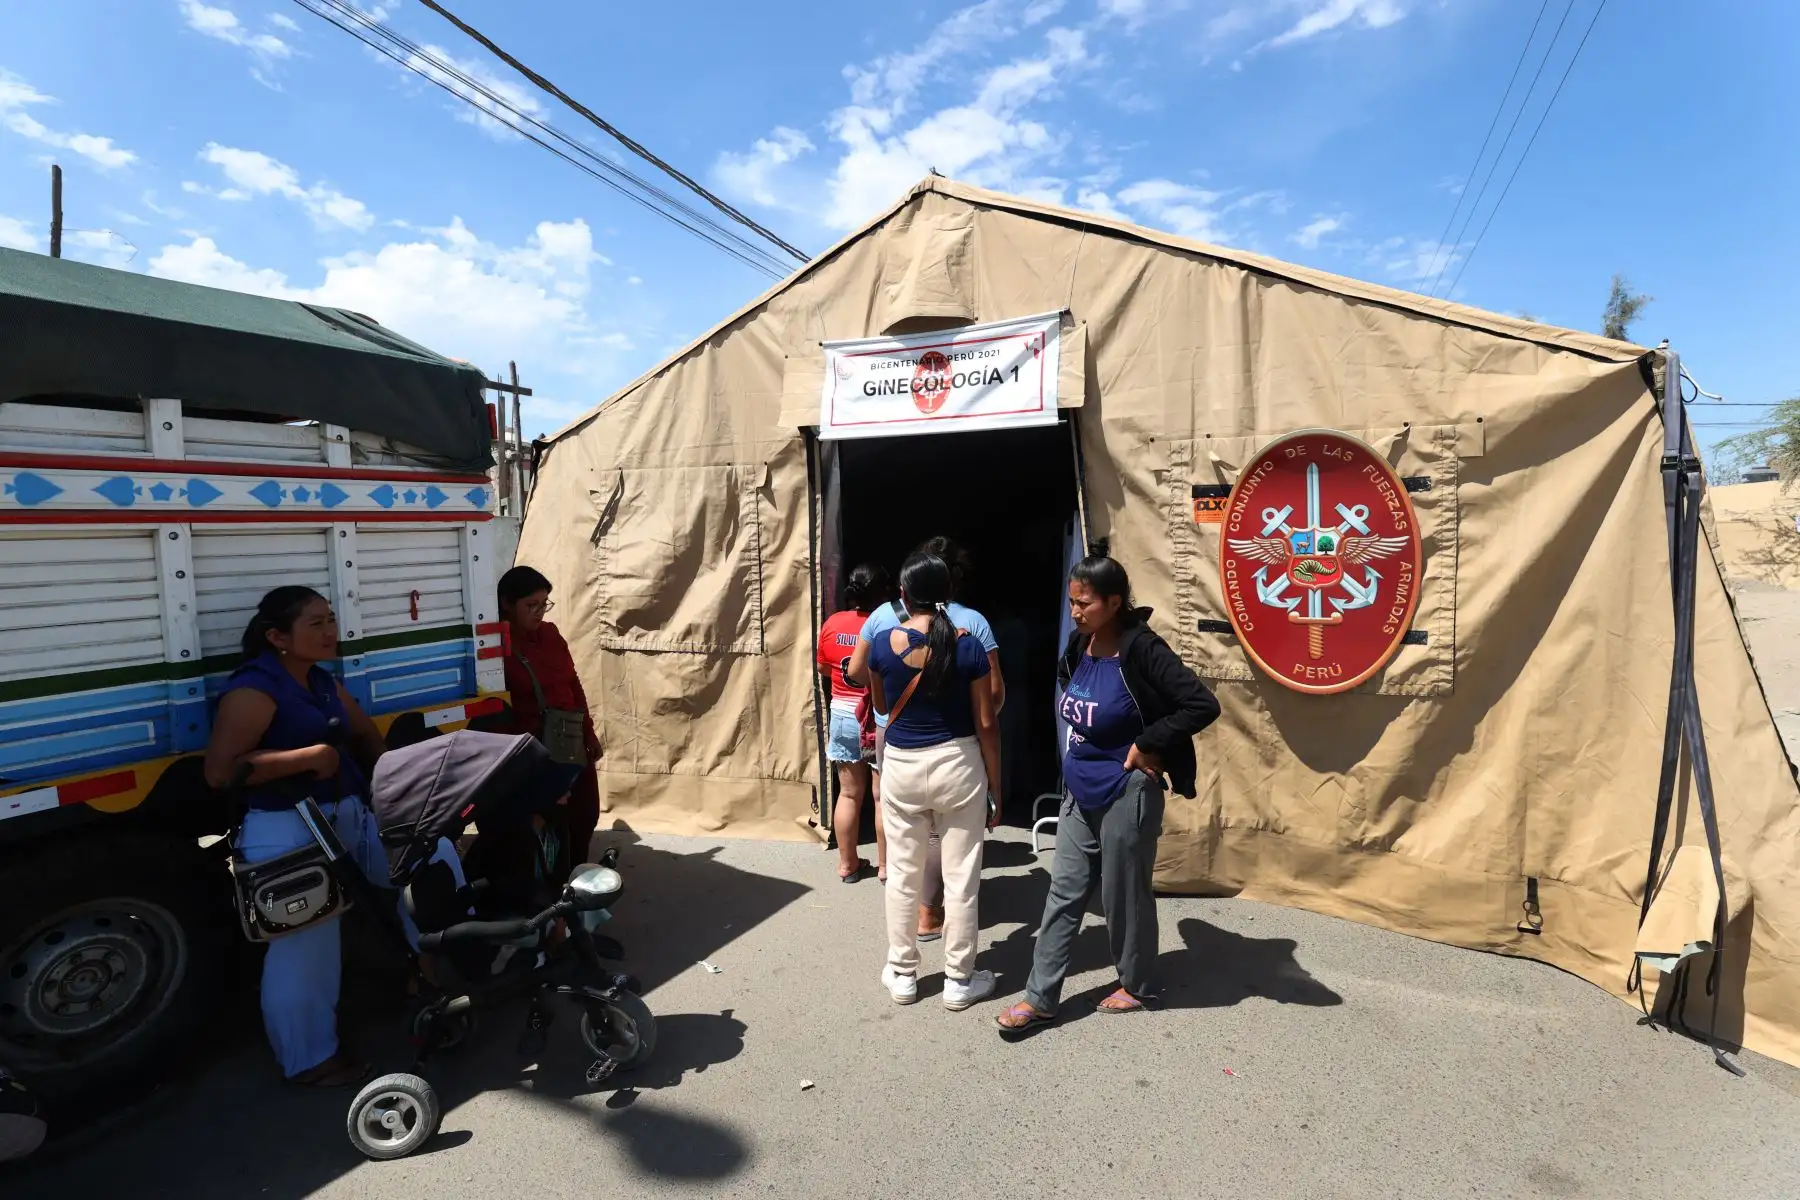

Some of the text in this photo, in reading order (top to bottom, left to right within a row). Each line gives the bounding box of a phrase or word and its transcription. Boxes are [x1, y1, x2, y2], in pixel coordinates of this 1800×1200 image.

[870, 349, 1000, 370] BICENTENARIO PERÚ 2021
[863, 364, 1004, 396] GINECOLOGÍA
[1010, 365, 1020, 383] 1
[1226, 444, 1412, 635] COMANDO CONJUNTO DE LAS FUERZAS ARMADAS
[836, 632, 859, 646] SILVI
[1292, 662, 1343, 679] PERÚ
[1059, 692, 1099, 727] EST
